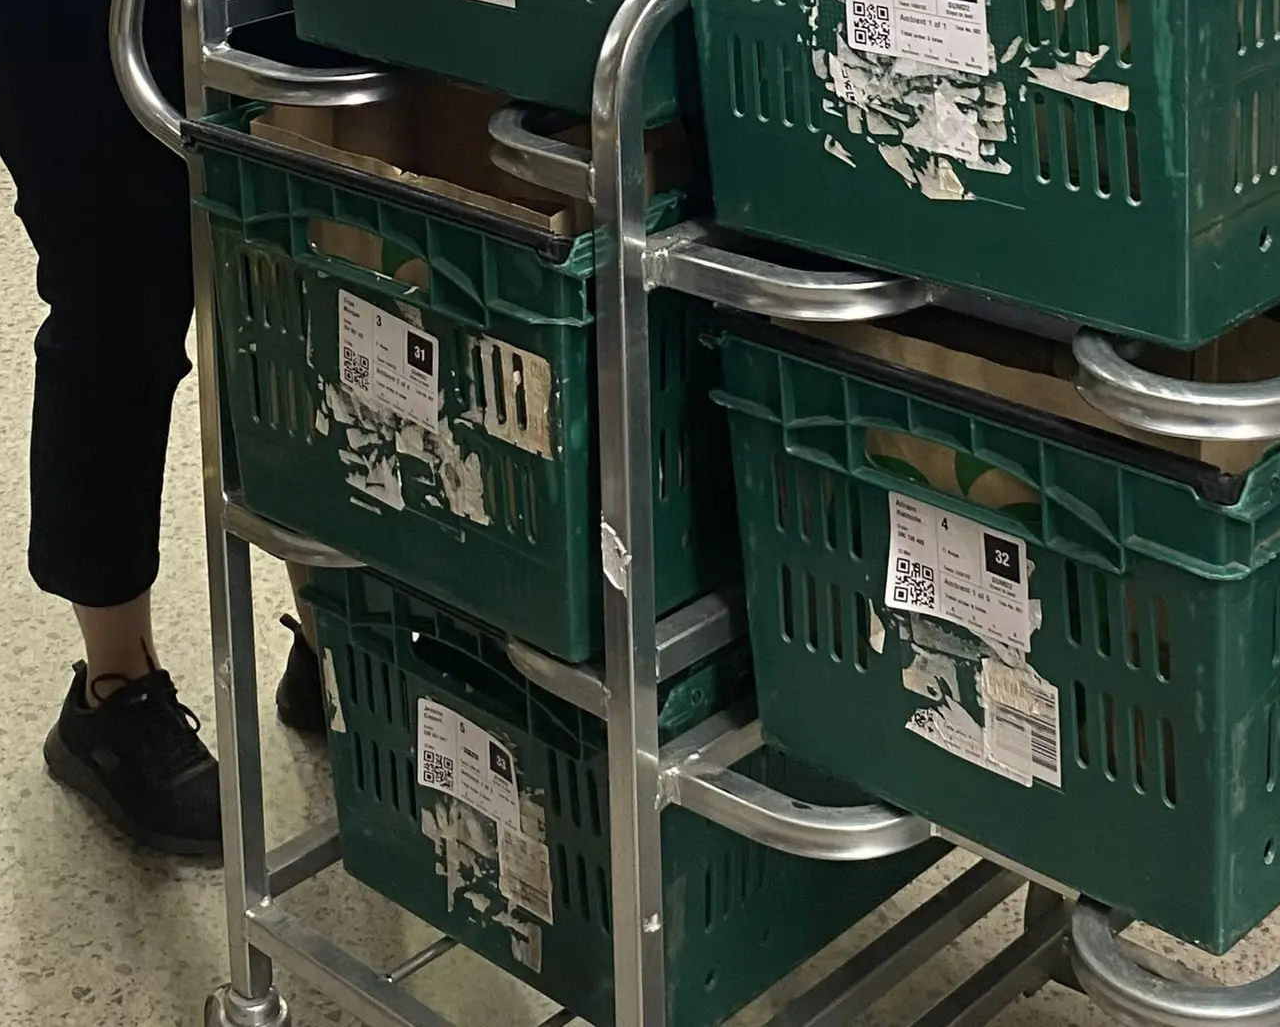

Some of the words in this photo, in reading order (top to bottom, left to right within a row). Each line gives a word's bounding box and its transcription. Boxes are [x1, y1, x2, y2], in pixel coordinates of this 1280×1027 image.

[375, 313, 381, 328] 3
[413, 343, 425, 362] 31
[941, 516, 948, 531] 4
[994, 548, 1010, 567] 32
[459, 722, 466, 734] 5
